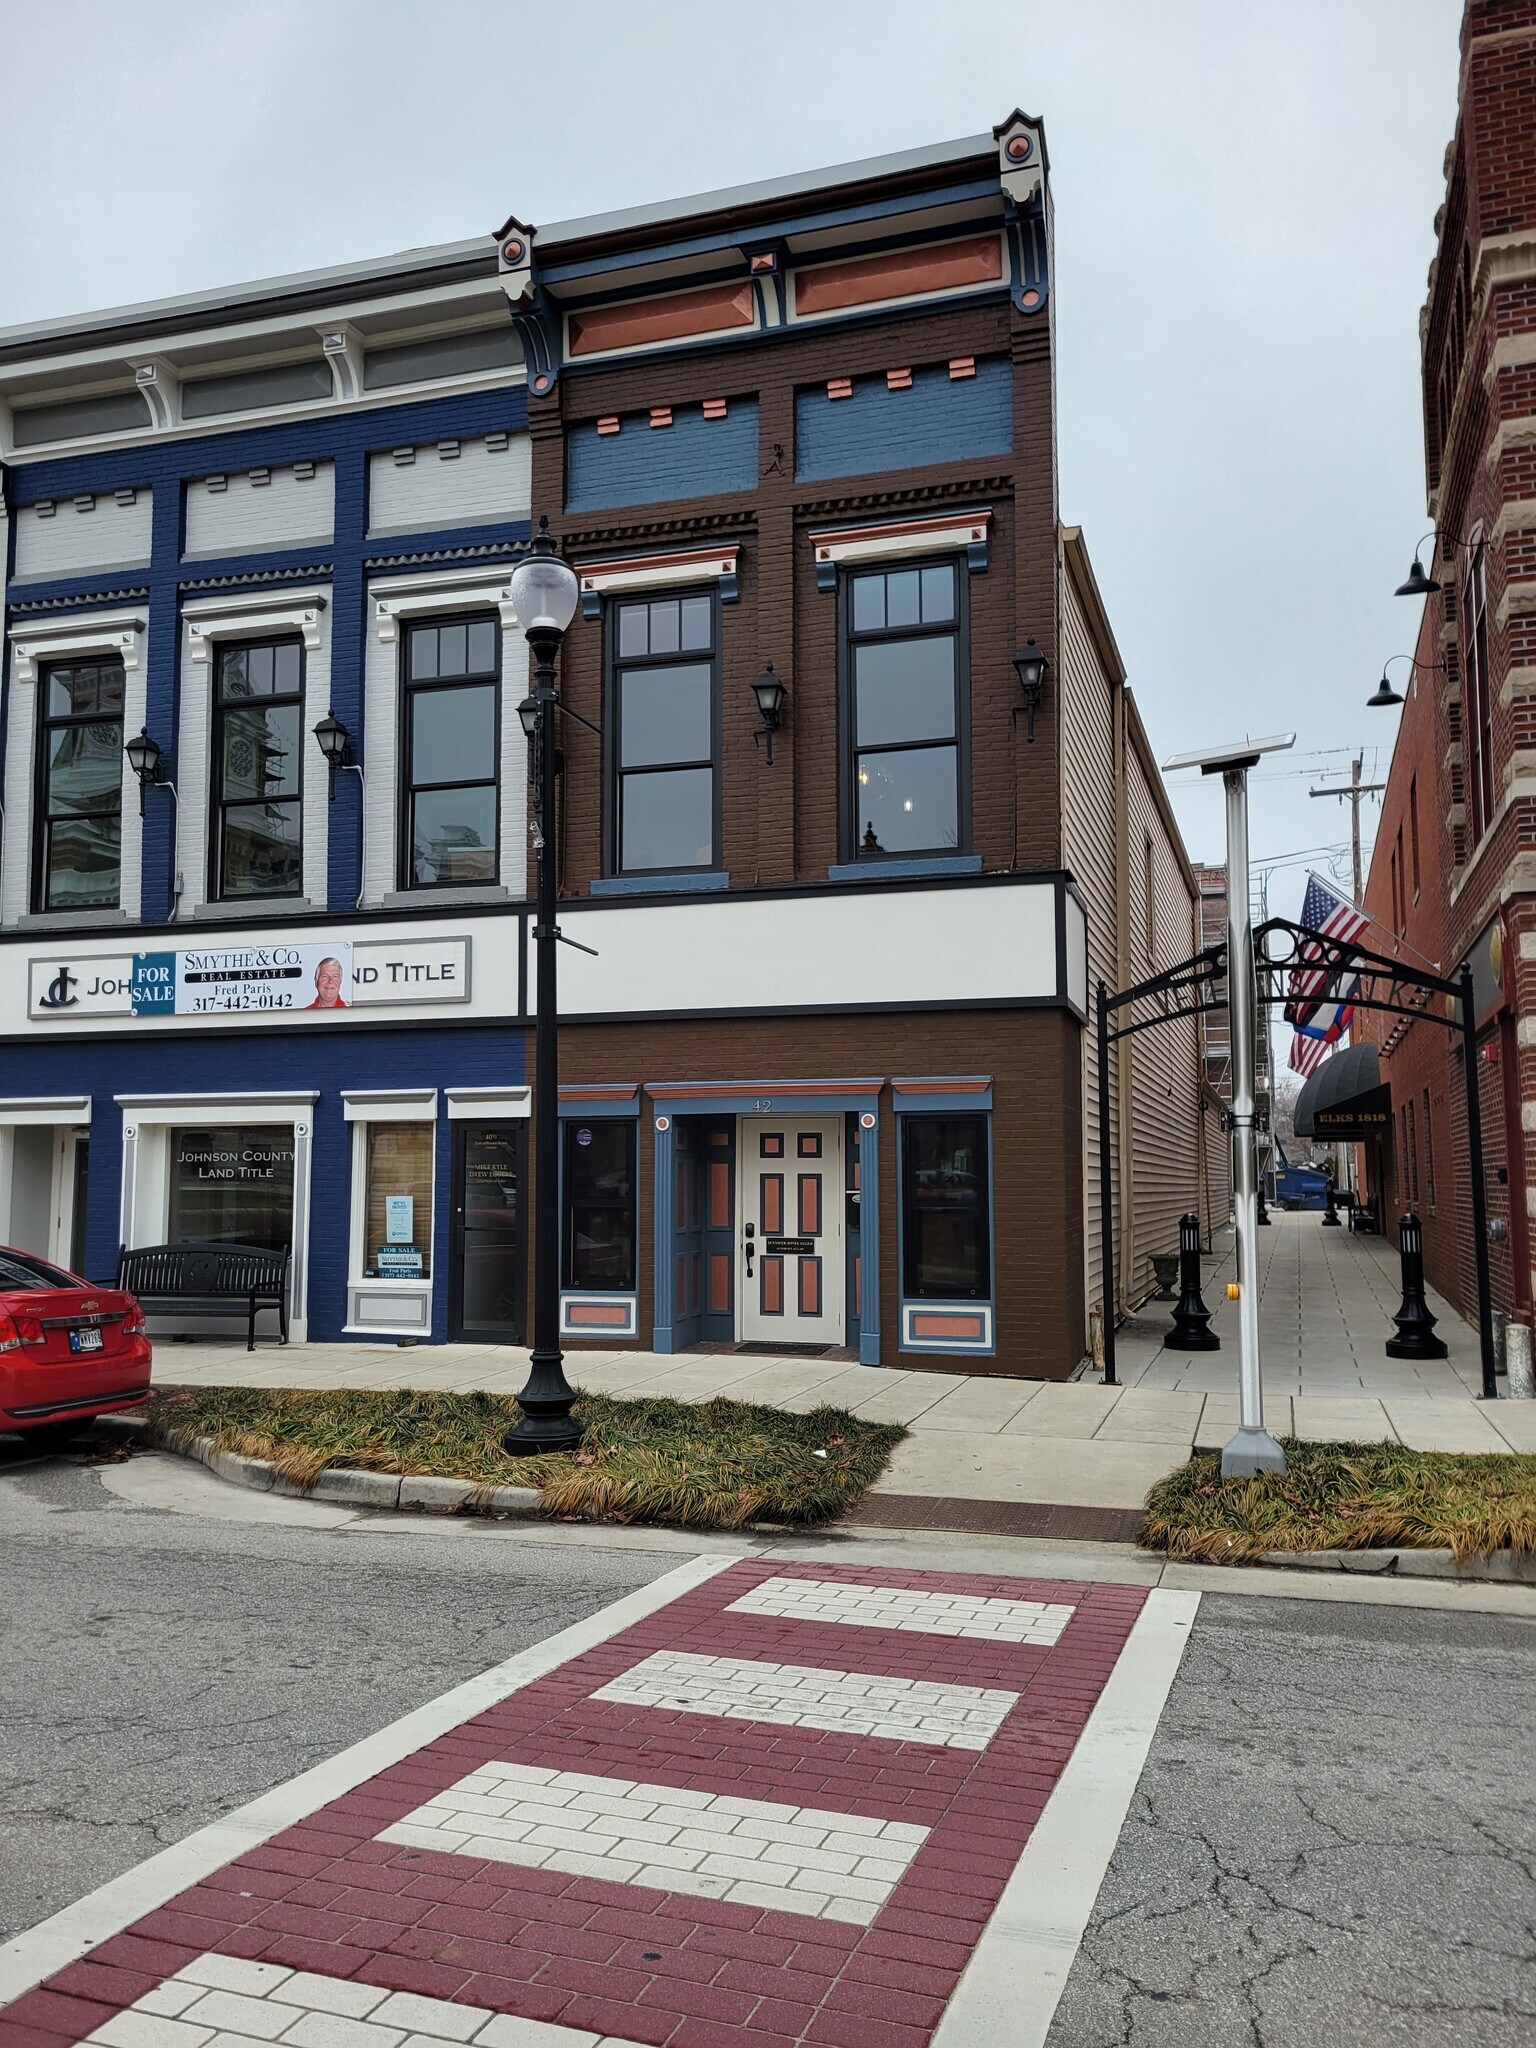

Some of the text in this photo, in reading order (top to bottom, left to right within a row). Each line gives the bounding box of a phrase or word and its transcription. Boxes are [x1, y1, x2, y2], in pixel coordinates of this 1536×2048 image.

[87, 962, 455, 995] JOH ND TITLE
[137, 967, 170, 983] FOR
[201, 969, 286, 982] REAL ESTATE
[132, 986, 174, 1002] SALE
[214, 983, 272, 996] Fred Paris
[192, 994, 293, 1013] 317-442-0142
[752, 1100, 771, 1113] 42
[1319, 1113, 1387, 1123] ELKS 1818
[177, 1150, 295, 1163] JOHNSON COUNTY
[199, 1166, 275, 1179] LAND TITLE
